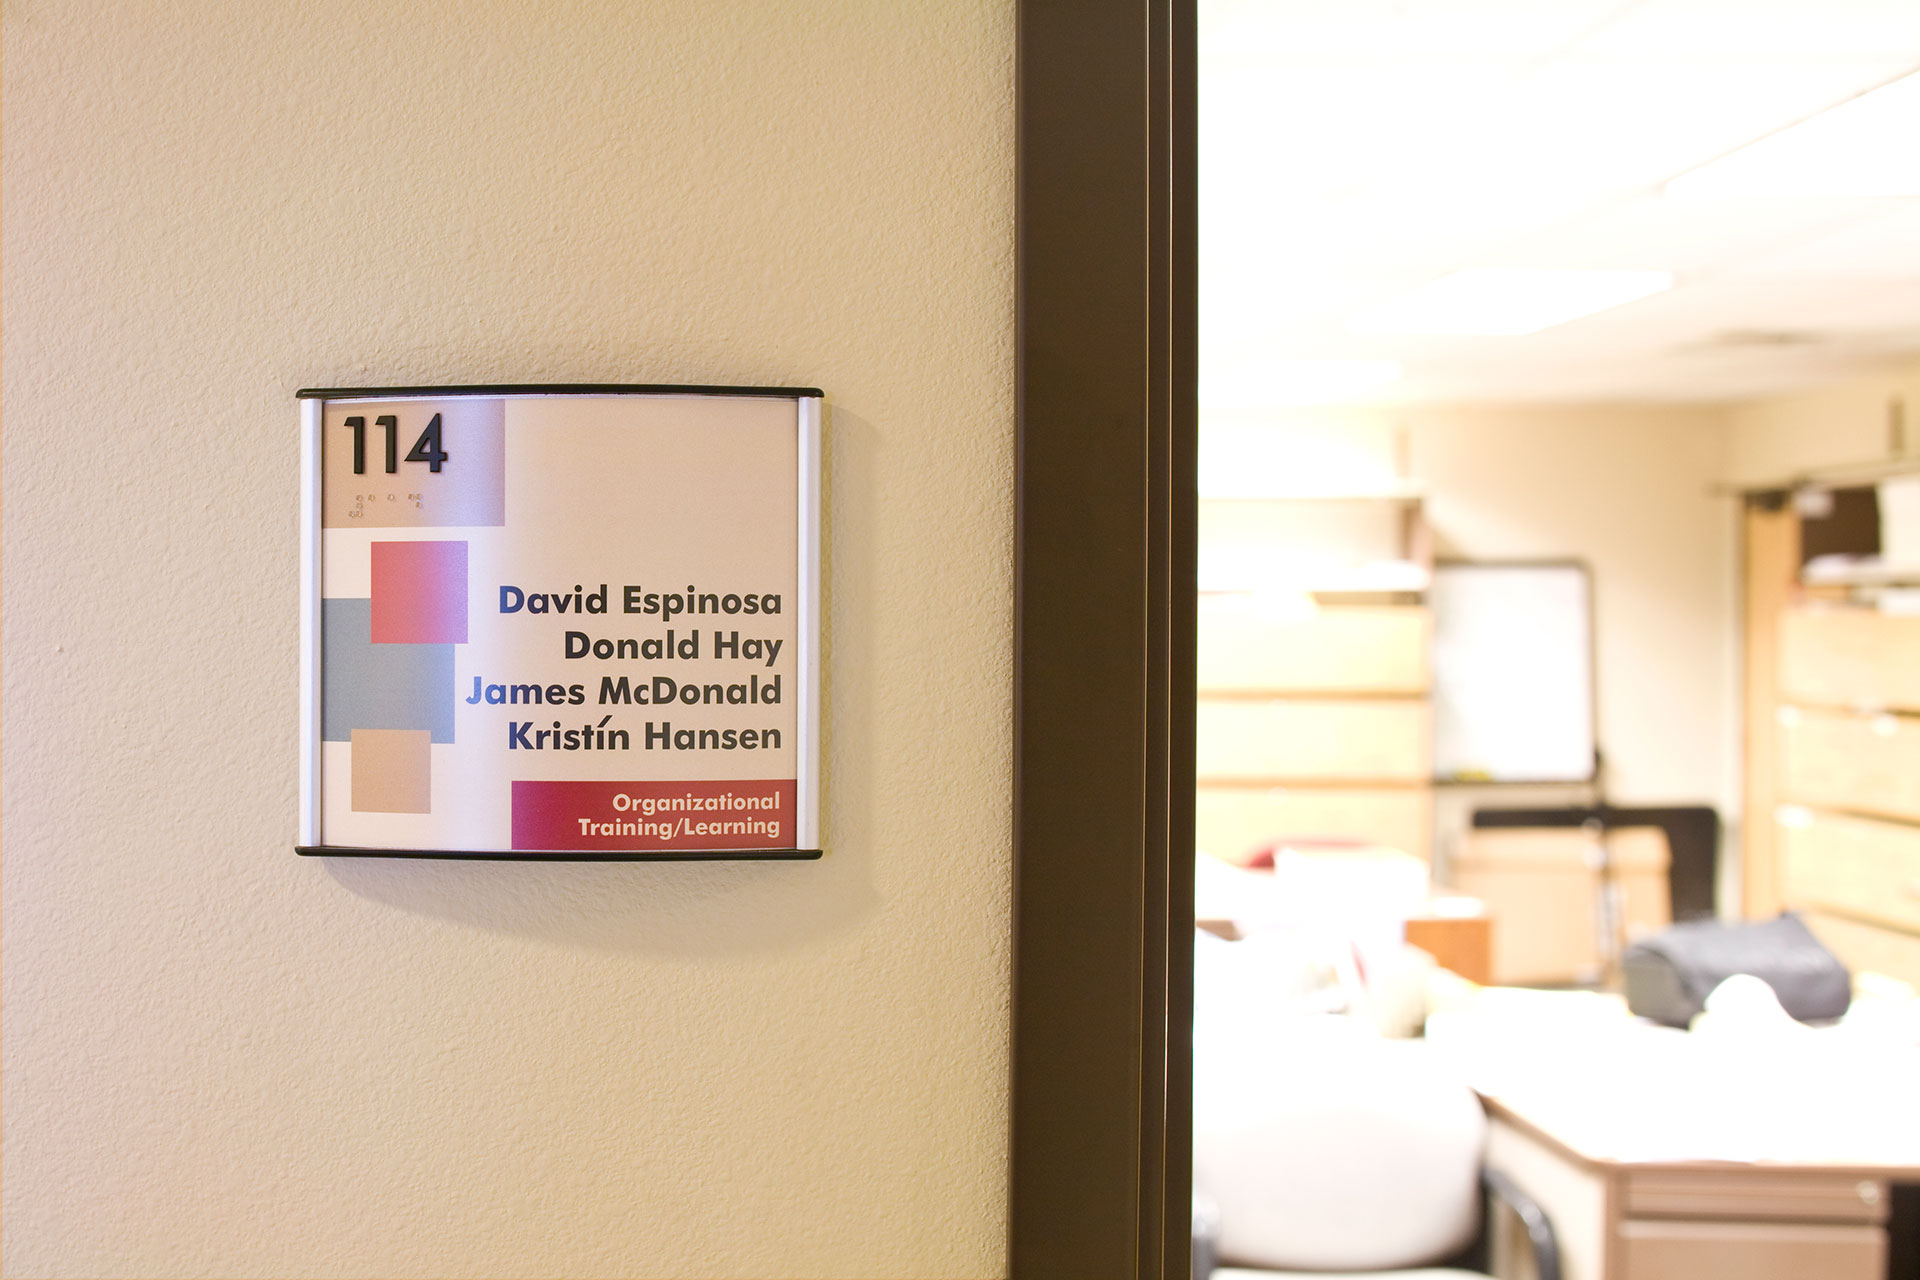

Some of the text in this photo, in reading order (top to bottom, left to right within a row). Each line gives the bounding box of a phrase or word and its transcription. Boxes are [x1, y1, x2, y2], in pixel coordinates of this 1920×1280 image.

[343, 412, 449, 475] 114
[499, 584, 782, 622] David Espinosa
[564, 630, 783, 667] Donald Hay
[465, 674, 782, 705] James McDonald
[508, 714, 782, 751] Kristín Hansen
[612, 791, 781, 816] Organizational
[578, 817, 781, 840] Training/Learning
